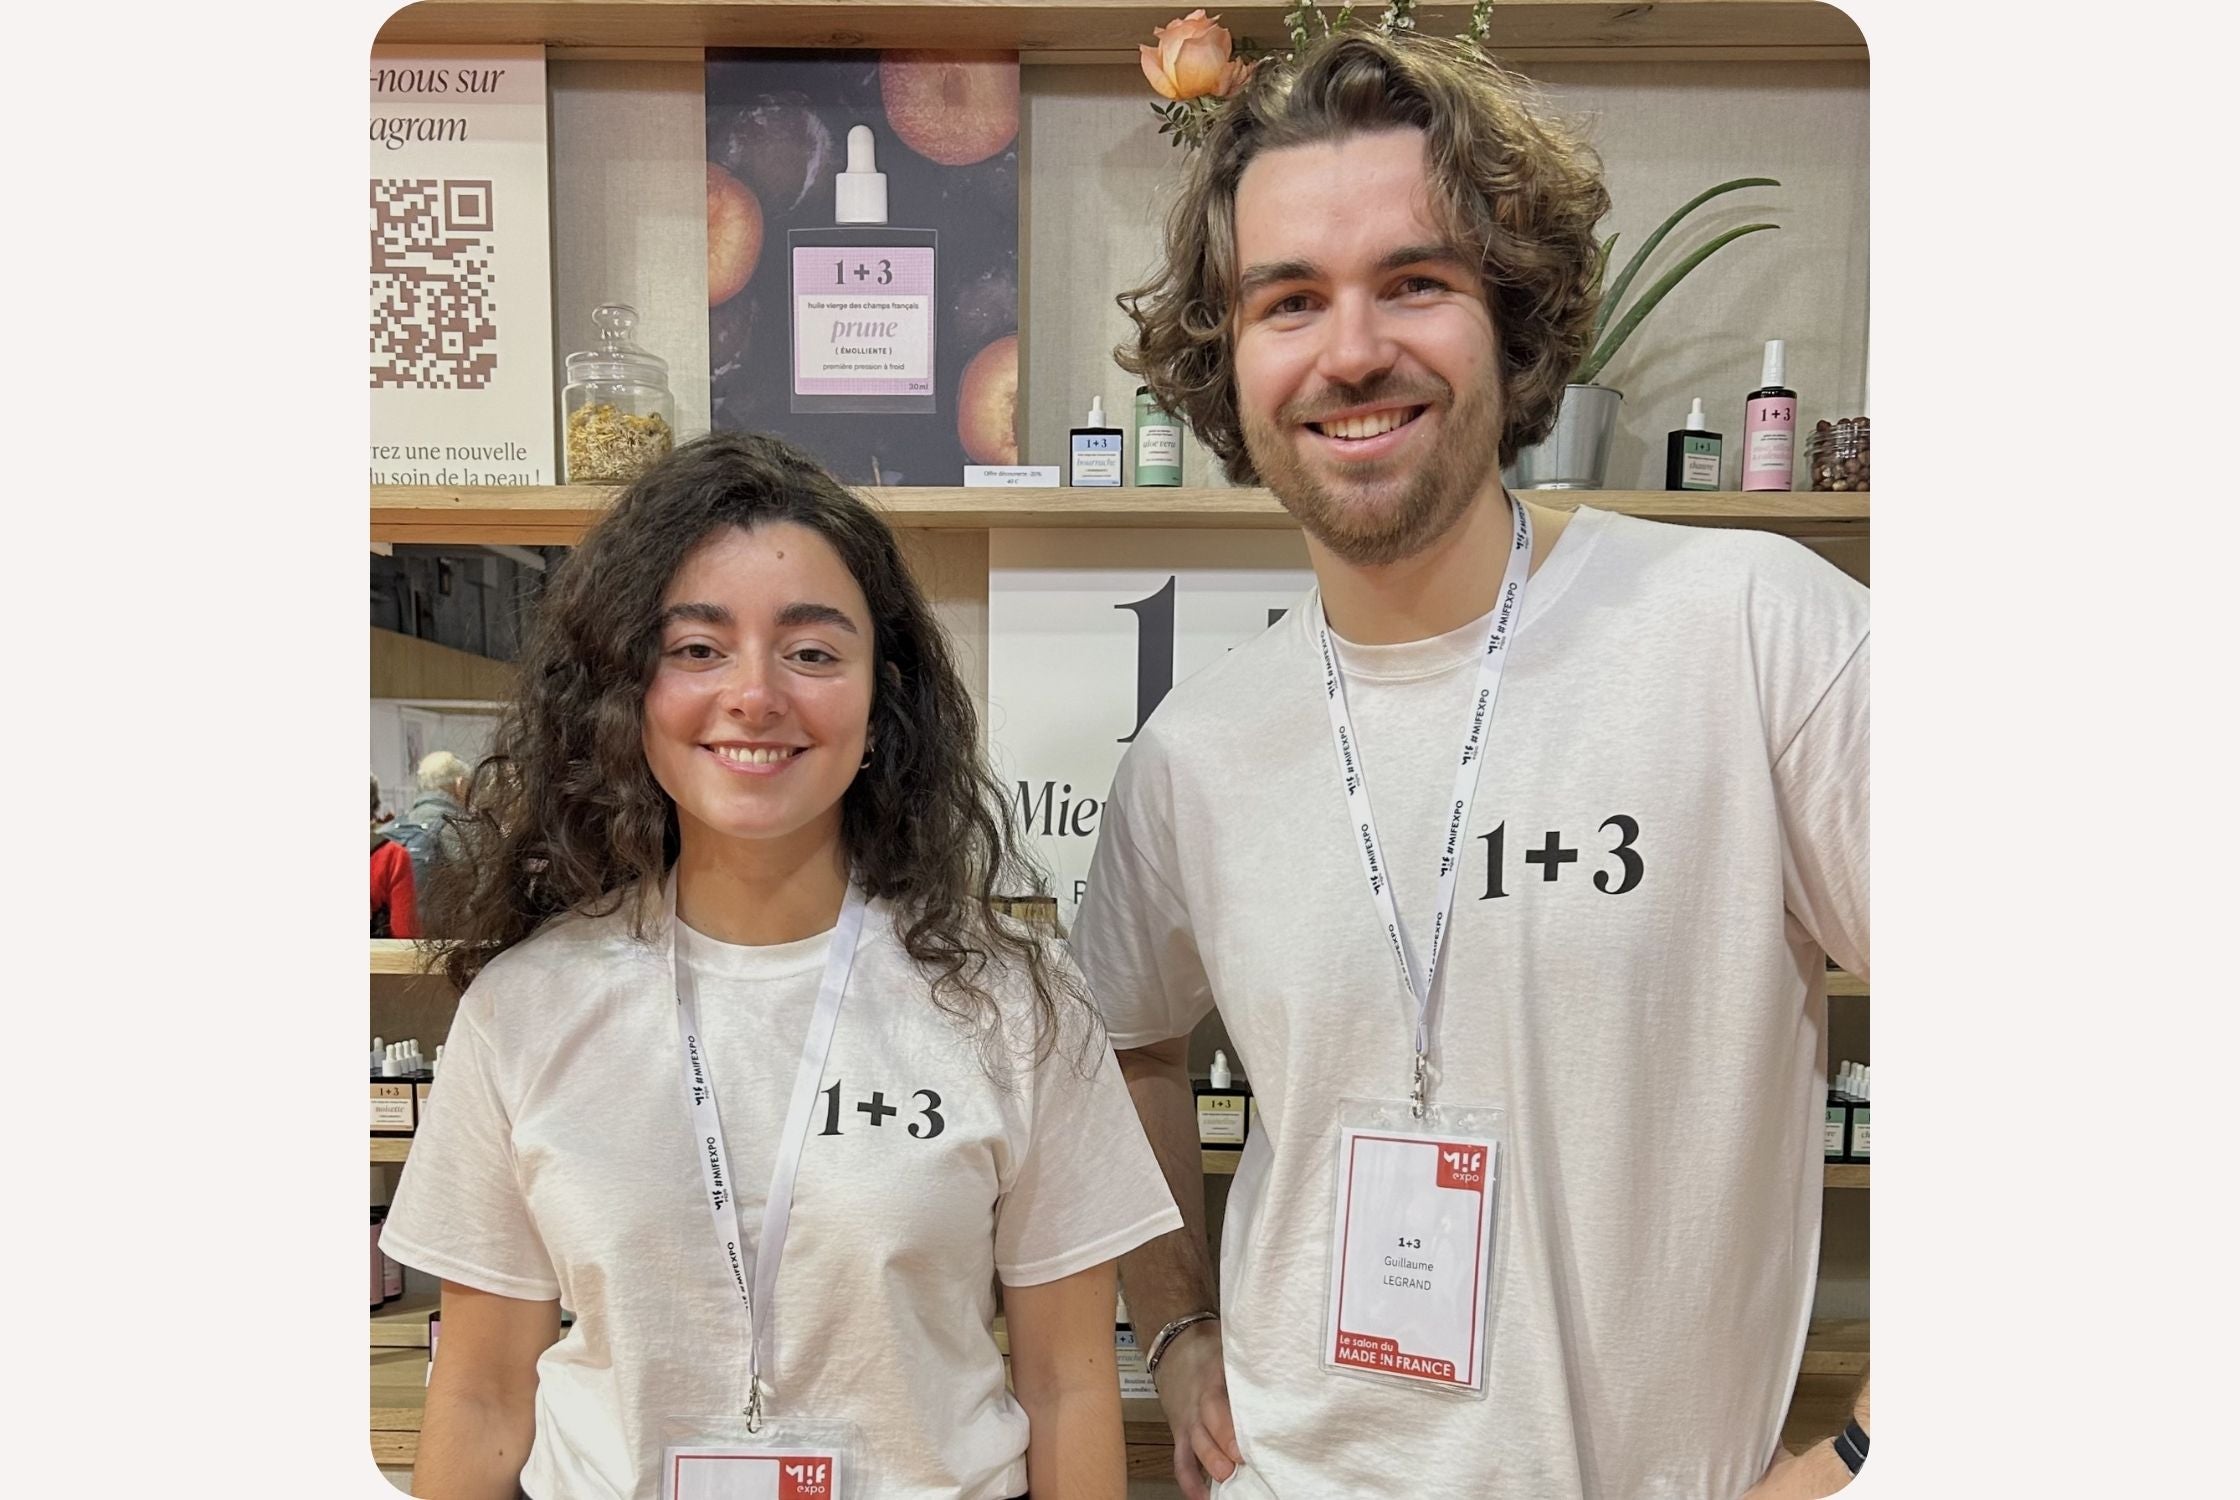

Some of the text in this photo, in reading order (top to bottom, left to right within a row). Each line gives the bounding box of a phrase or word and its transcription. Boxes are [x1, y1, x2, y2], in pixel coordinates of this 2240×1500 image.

[455, 69, 506, 93] sur
[370, 117, 468, 151] agram
[862, 302, 891, 311] champs
[830, 320, 899, 344] prune
[370, 442, 528, 461] rez une nouvelle
[391, 468, 431, 486] soin
[435, 468, 459, 486] de
[463, 468, 479, 486] la
[1470, 688, 1490, 744] #MIFEXPO
[1446, 799, 1464, 855] #MIFEXPO
[1361, 823, 1379, 872] #MIFEXPO
[687, 1035, 704, 1084] #MIFEXPO
[706, 1136, 724, 1187] #MIFEXPO
[1452, 1172, 1480, 1184] expo
[1398, 1237, 1421, 1249] 1+3
[1384, 1255, 1434, 1272] Guillaume
[1383, 1275, 1432, 1291] LEGRAND
[1340, 1334, 1394, 1352] Le salon du
[1338, 1347, 1377, 1364] MADE
[1396, 1355, 1452, 1377] FRANCE
[796, 1485, 826, 1496] expo
